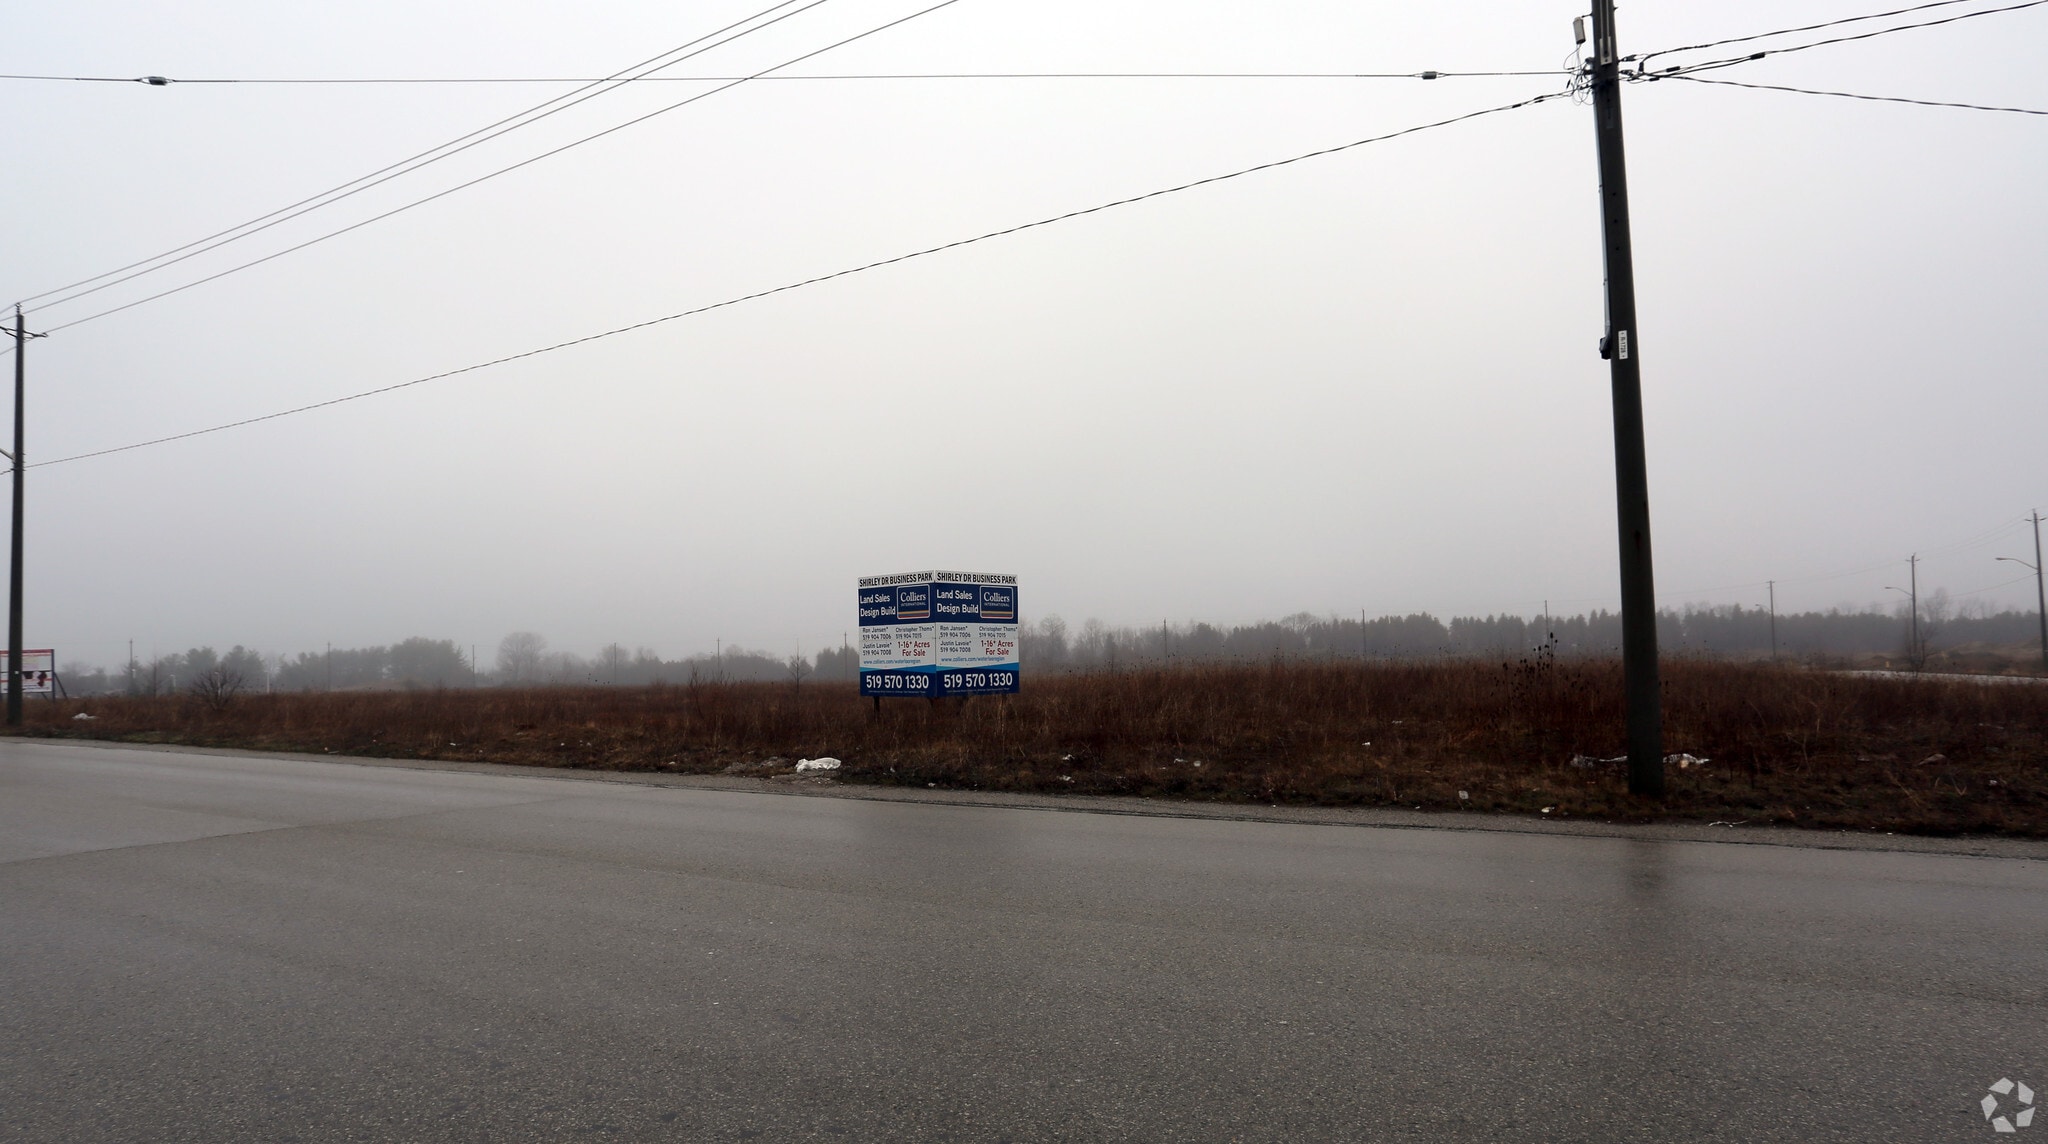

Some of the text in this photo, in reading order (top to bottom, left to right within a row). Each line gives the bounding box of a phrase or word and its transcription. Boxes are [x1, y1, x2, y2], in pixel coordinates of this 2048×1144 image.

[860, 578, 880, 586] SHIRLEY
[890, 574, 916, 584] BUSINESS
[937, 573, 963, 581] SHIRLEY
[973, 575, 1000, 583] BUSINESS
[860, 594, 890, 603] Land Sales
[901, 592, 926, 602] Colliers
[937, 590, 972, 599] Land Sales
[984, 592, 1009, 602] Colliers
[860, 606, 895, 618] Design Build
[937, 604, 978, 614] Design Build
[866, 675, 929, 688] 519 570 1330
[944, 673, 1012, 688] 519 570 1330
